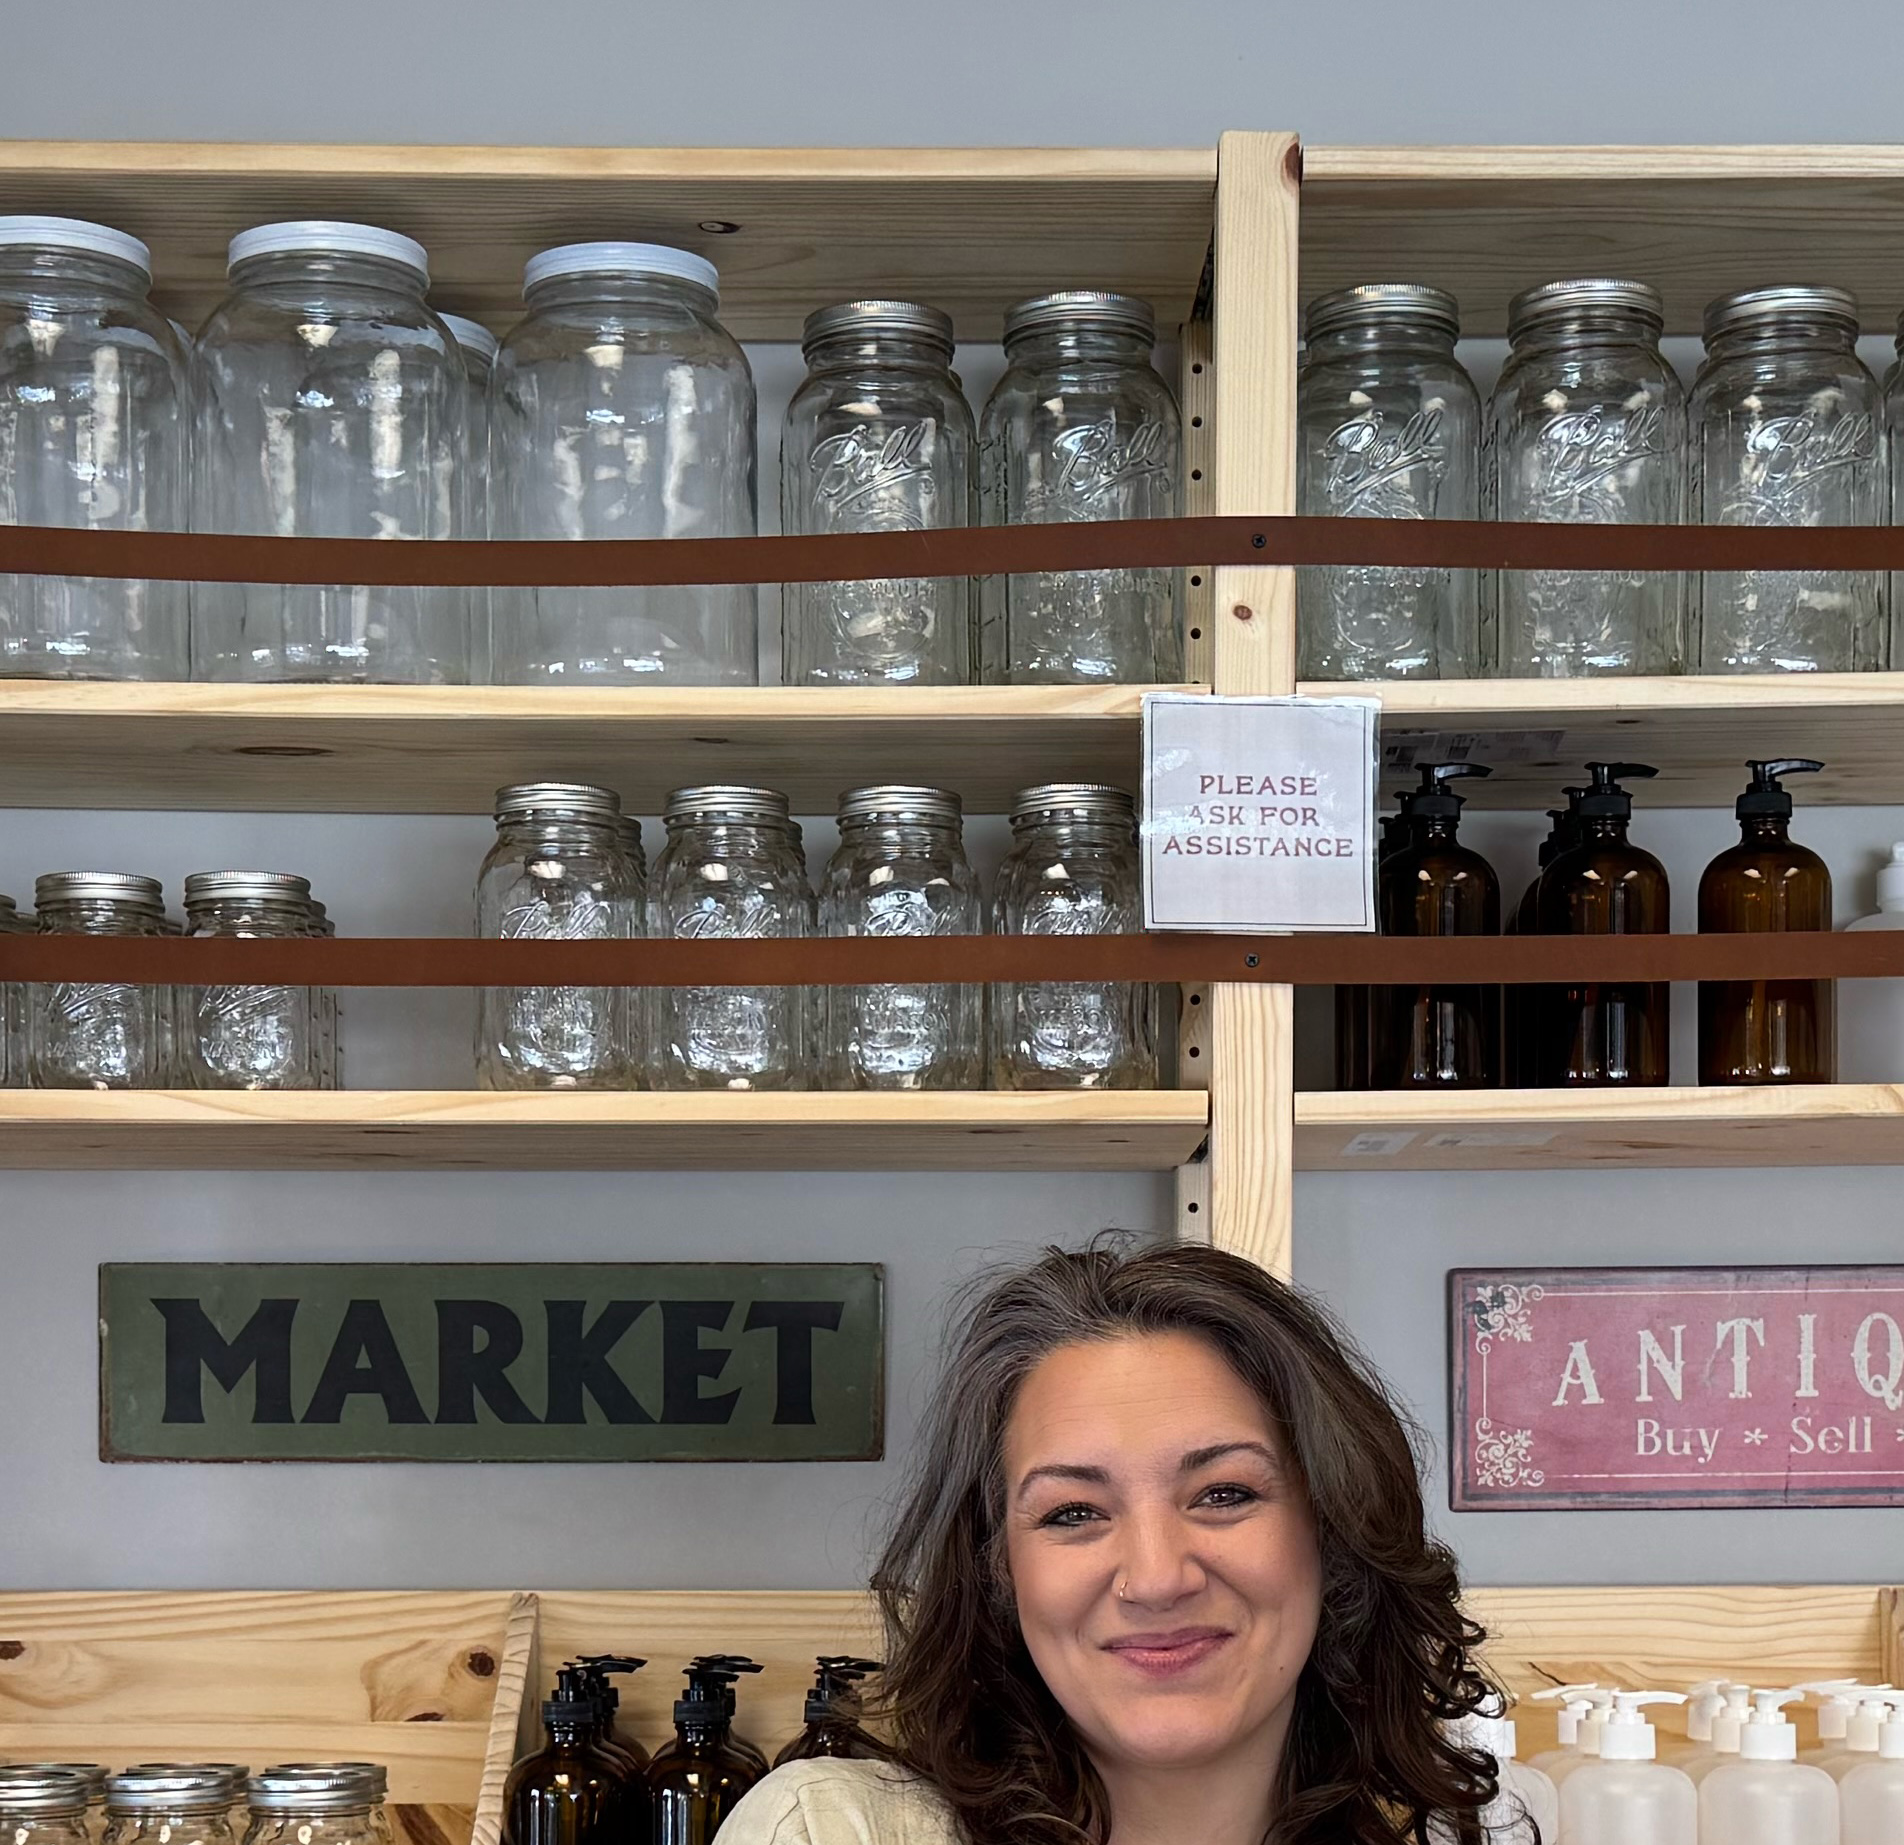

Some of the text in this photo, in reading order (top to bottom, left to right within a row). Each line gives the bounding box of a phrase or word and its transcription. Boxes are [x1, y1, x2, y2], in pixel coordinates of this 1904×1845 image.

[1052, 419, 1166, 499] Ball
[1325, 408, 1444, 494] Ball
[1540, 406, 1668, 495] Ball
[1746, 408, 1874, 493] Ball
[1189, 805, 1321, 827] ASK FOR
[1199, 775, 1318, 796] PLEASE
[1162, 835, 1354, 858] ASSISTANCE
[149, 1298, 845, 1426] MARKET
[1634, 1416, 1722, 1464] Buy
[1789, 1415, 1874, 1455] Sell
